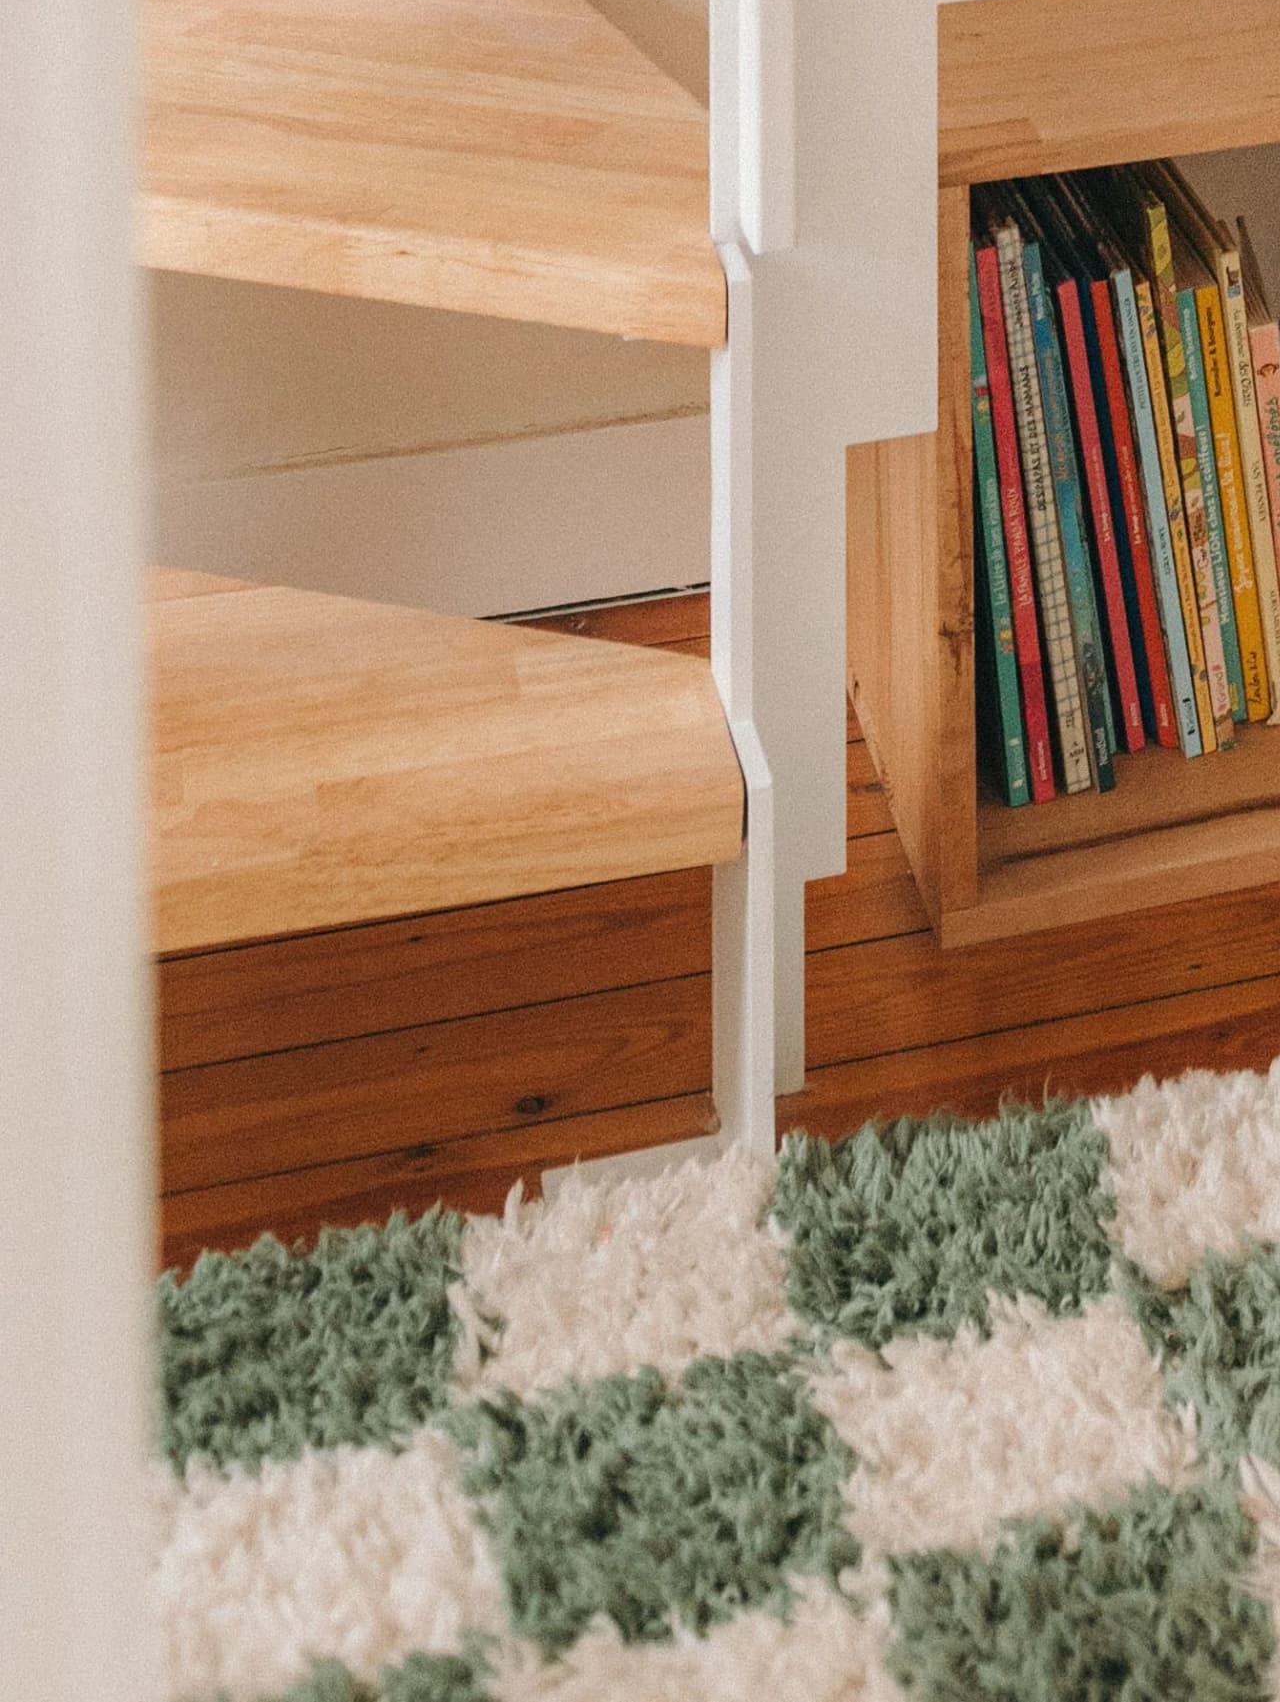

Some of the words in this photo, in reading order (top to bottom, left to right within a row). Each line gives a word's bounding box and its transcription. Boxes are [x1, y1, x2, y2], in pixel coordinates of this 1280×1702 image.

[1238, 360, 1249, 376] des
[1019, 364, 1035, 417] MAMANS
[1239, 377, 1254, 406] Chats
[1026, 419, 1038, 438] DES
[1005, 486, 1020, 516] ROUX
[1035, 491, 1047, 511] DES
[1202, 483, 1214, 498] le
[1205, 502, 1218, 527] chez
[1213, 565, 1231, 623] Monsieur
